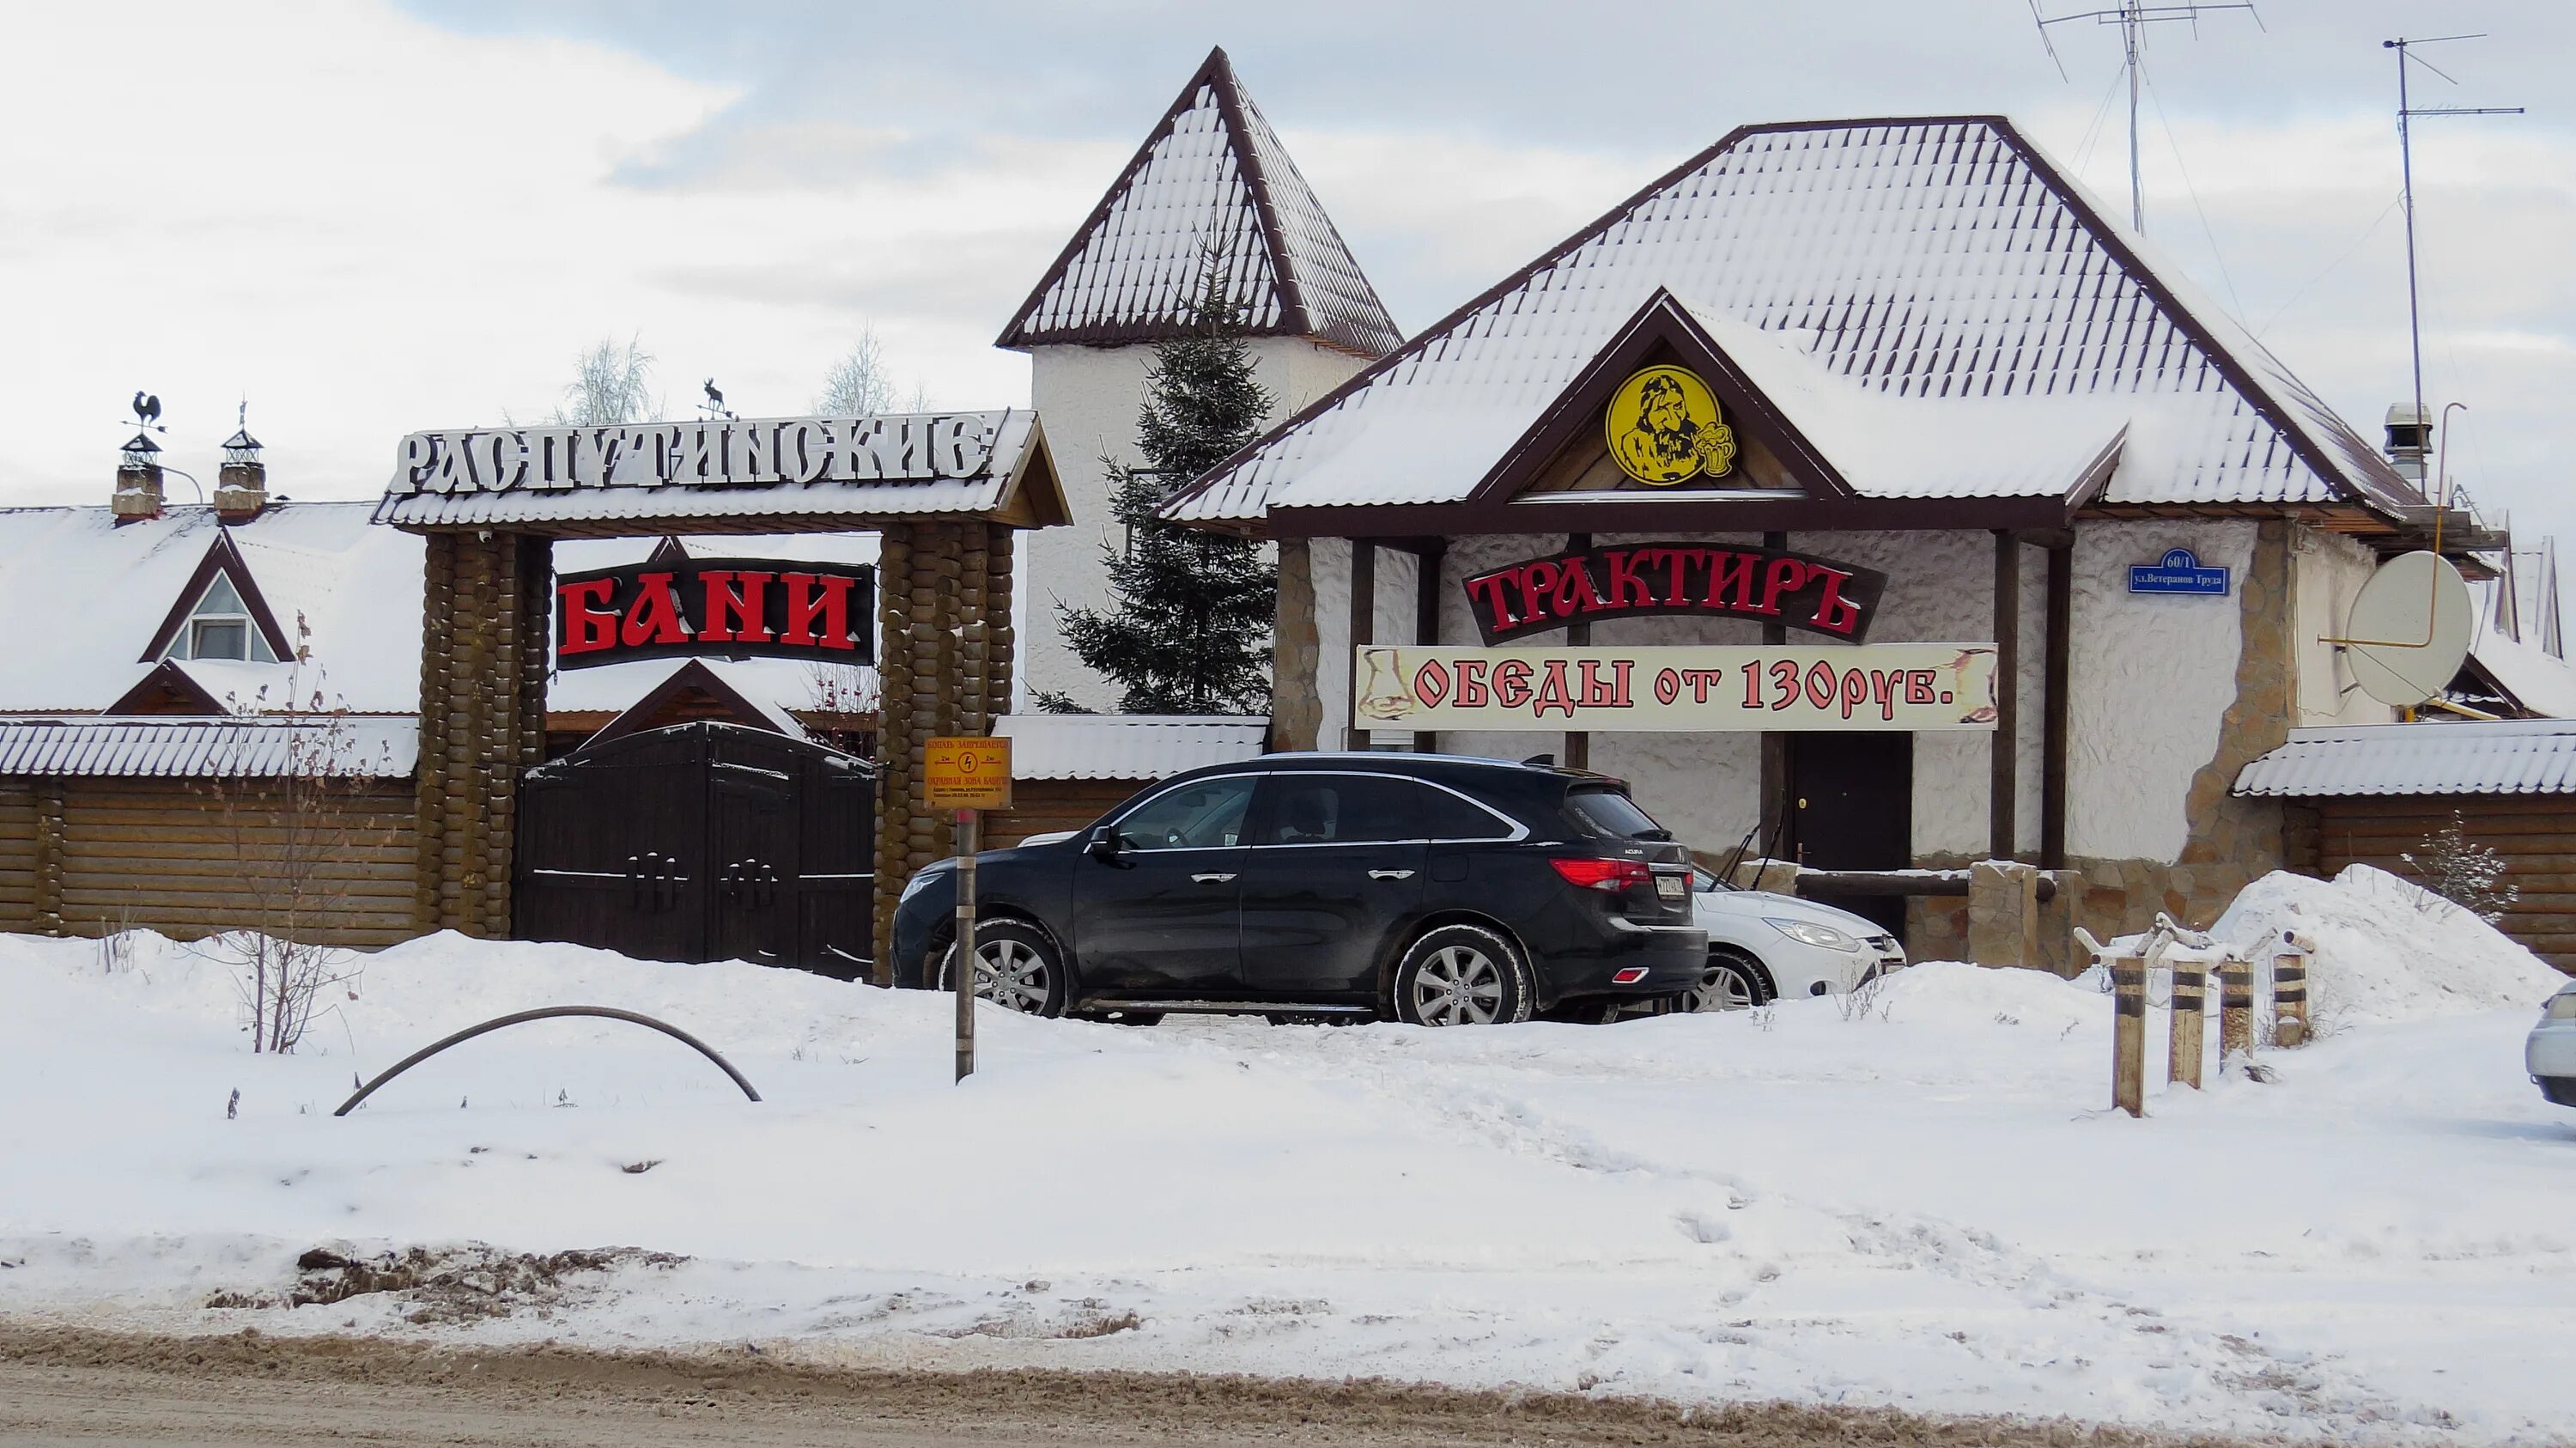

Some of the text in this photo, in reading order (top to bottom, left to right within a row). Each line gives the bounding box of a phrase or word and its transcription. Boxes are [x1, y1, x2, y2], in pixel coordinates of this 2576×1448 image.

[391, 415, 993, 494] РАСПУТИНСКИЕ
[1467, 549, 1862, 635] ТРАКТИРЪ
[2167, 557, 2190, 568] 60/1
[2196, 575, 2222, 587] Труда
[558, 570, 855, 655] БАНИ
[1413, 659, 1634, 718] ОБЕДЫ
[1654, 667, 1722, 706] от
